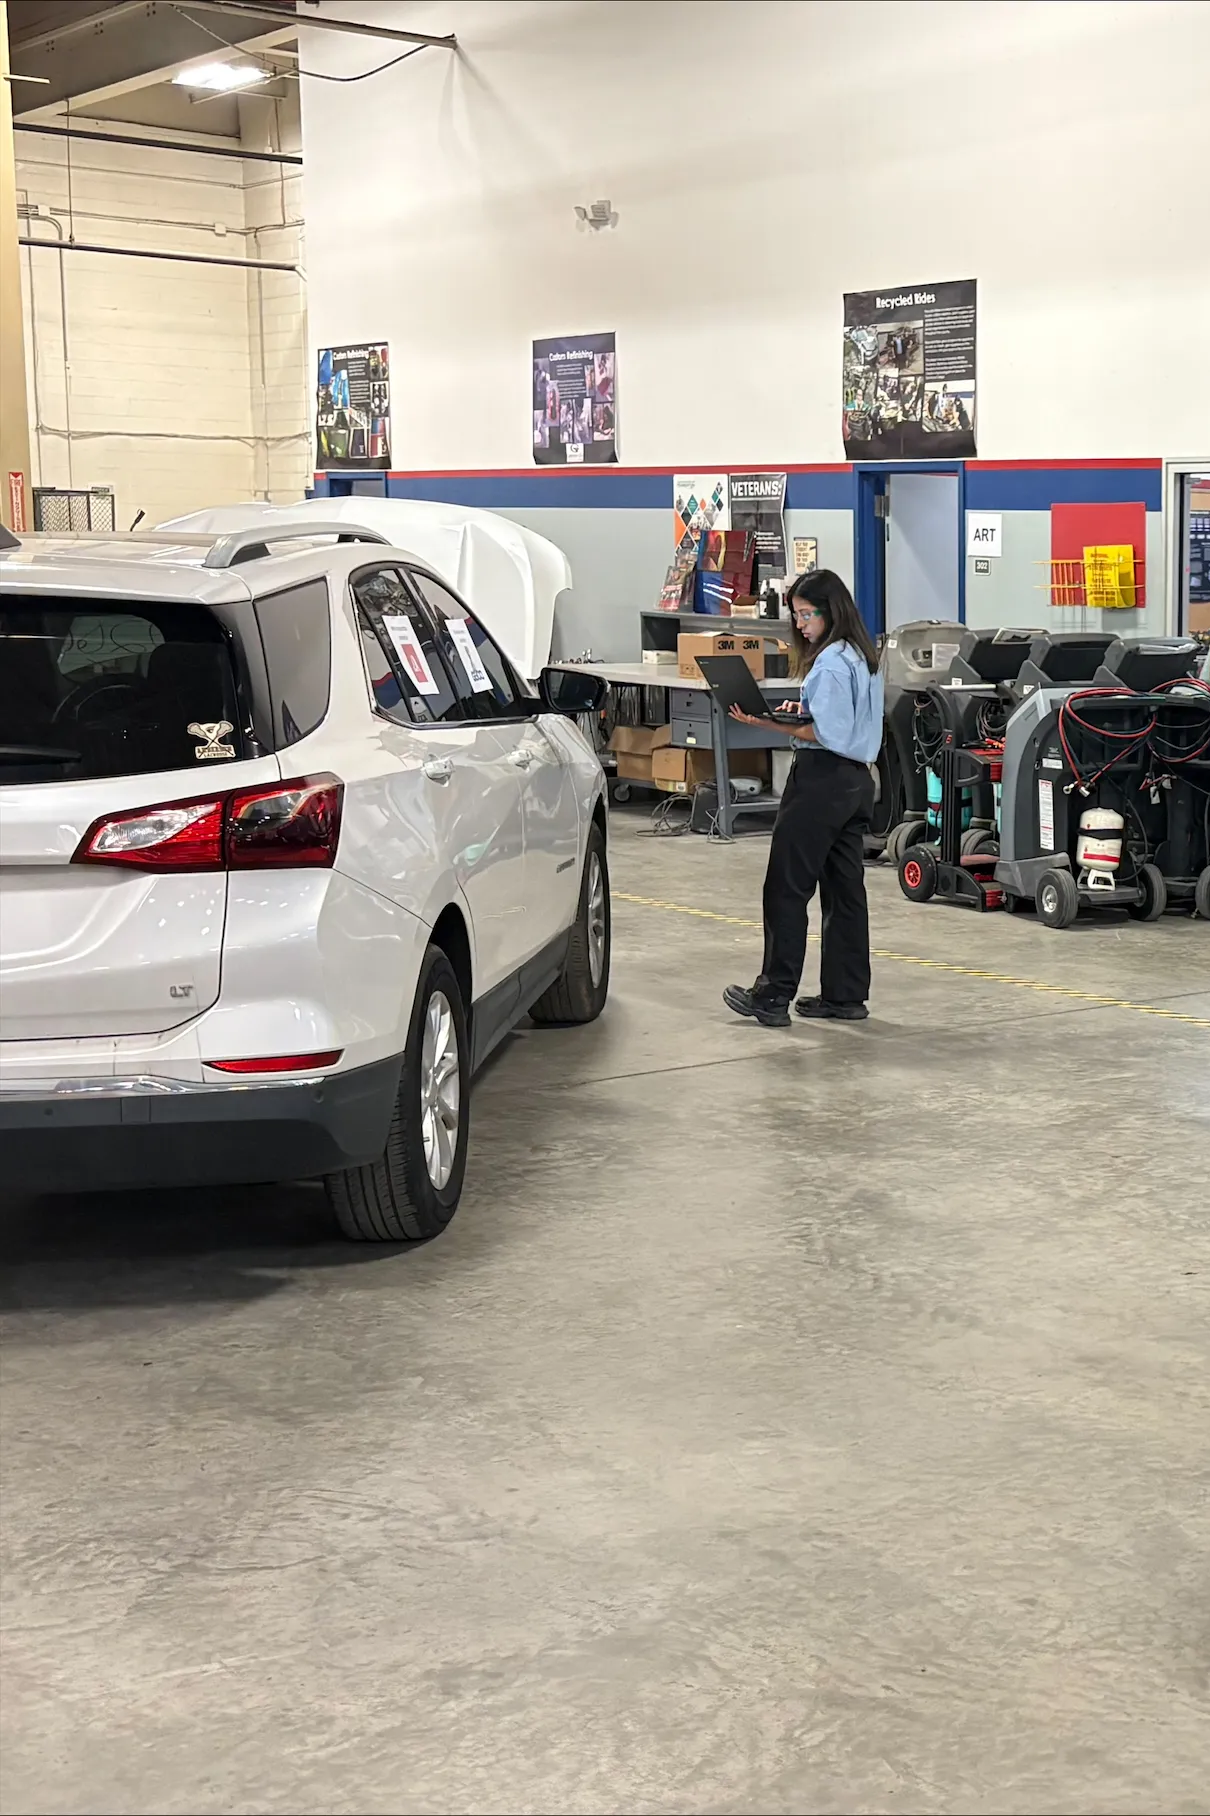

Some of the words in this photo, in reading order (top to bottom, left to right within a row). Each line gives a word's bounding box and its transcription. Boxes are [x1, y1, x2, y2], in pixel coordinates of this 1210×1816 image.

[875, 294, 913, 309] Recycled
[914, 292, 936, 305] Rides
[731, 481, 782, 496] VETERANS:
[973, 528, 996, 541] ART
[718, 640, 734, 650] 3M
[743, 640, 759, 649] 3M
[170, 985, 193, 997] LT
